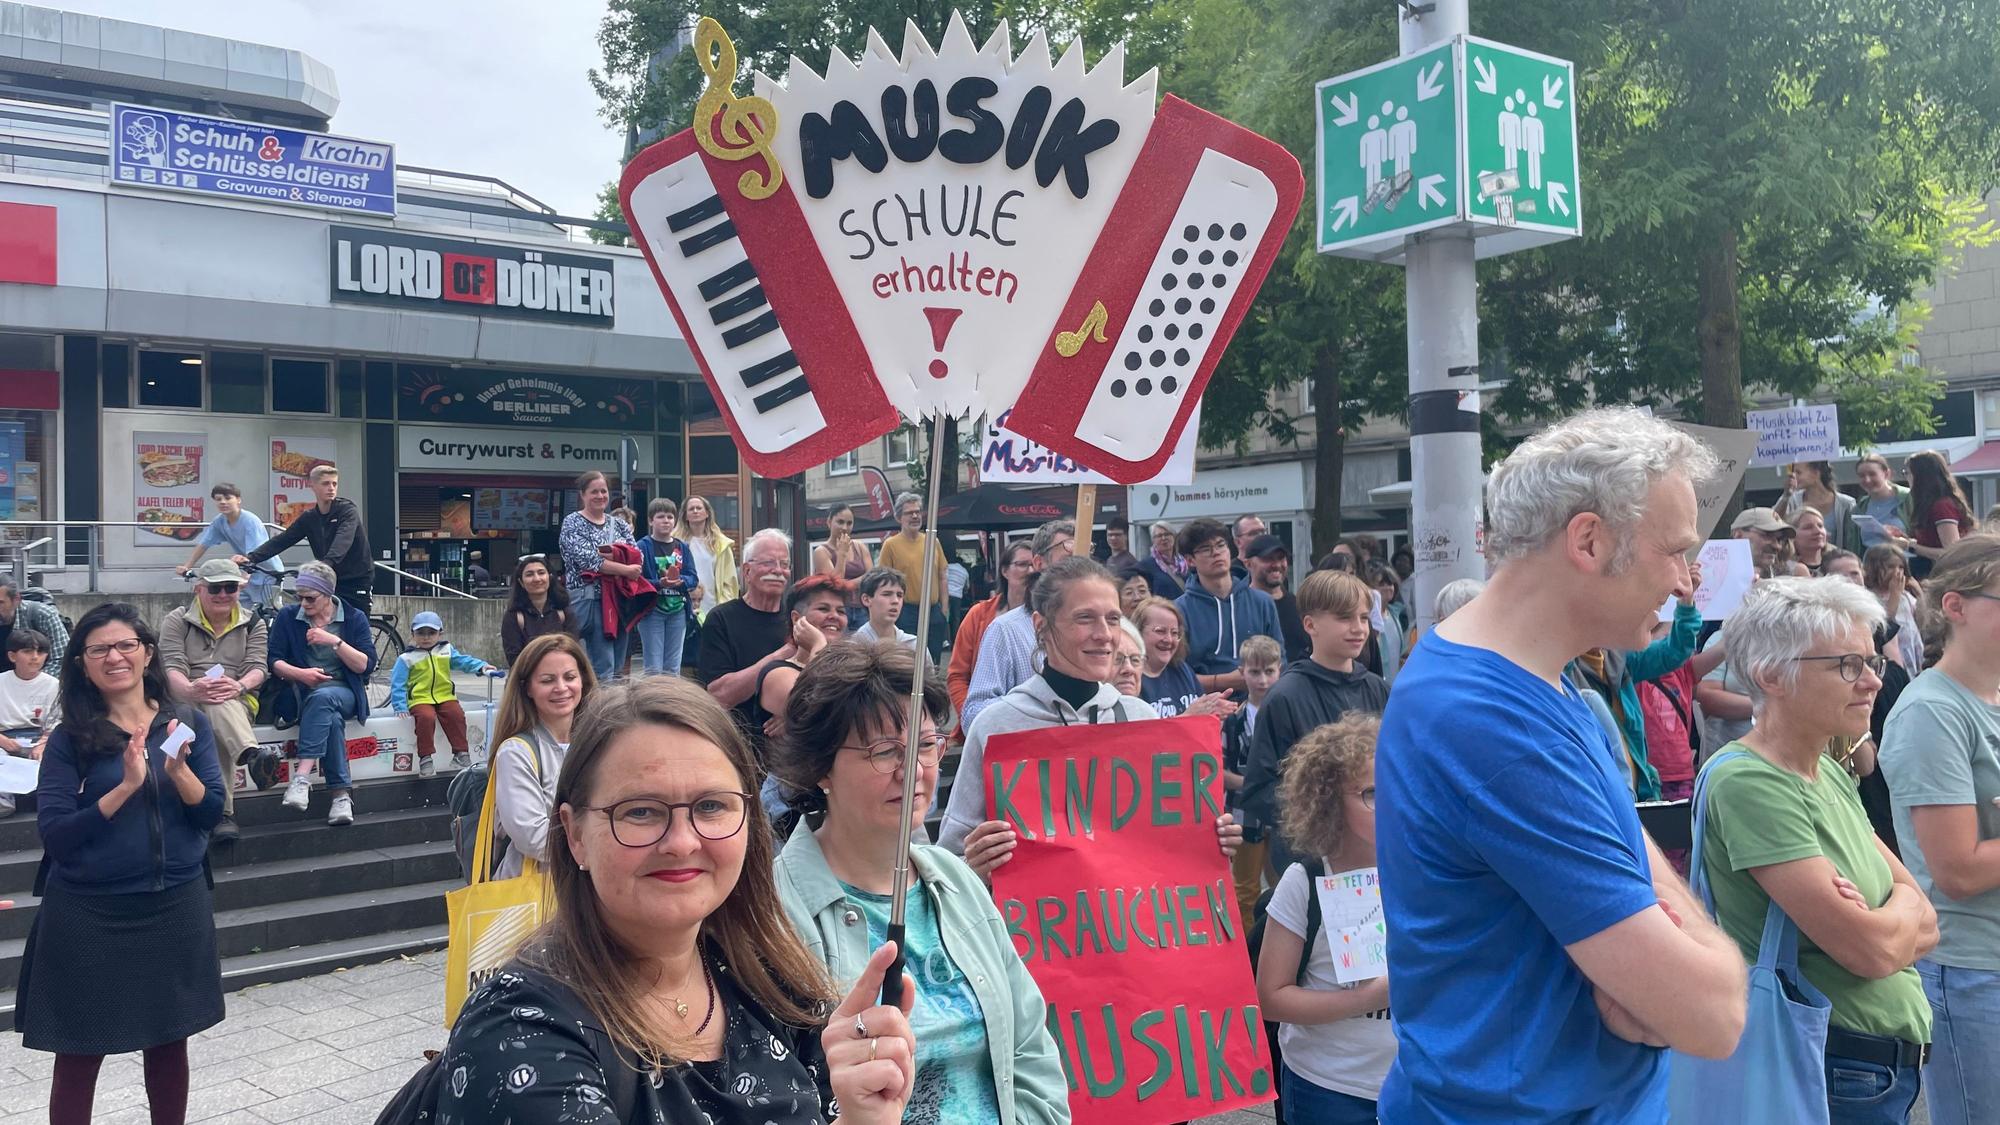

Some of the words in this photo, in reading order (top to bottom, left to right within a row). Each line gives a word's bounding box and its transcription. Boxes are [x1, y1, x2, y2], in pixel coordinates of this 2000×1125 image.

[173, 123, 255, 153] Schuh
[258, 136, 286, 162] &
[309, 139, 385, 168] Krahn
[800, 77, 1120, 199] MUSIK
[173, 147, 370, 191] Schlüsseldienst
[216, 178, 288, 199] Gravuren
[289, 187, 304, 202] &
[306, 189, 367, 208] Stempel
[839, 184, 1024, 260] SCHULE
[337, 239, 442, 300] LORD
[453, 261, 486, 296] OF
[496, 251, 614, 317] DÖNER
[872, 251, 1018, 304] erhalten
[923, 307, 963, 379] !
[476, 382, 507, 404] Unser
[506, 377, 564, 395] Geheimnis
[492, 400, 571, 415] BERLINER
[512, 412, 553, 423] Saucen
[418, 438, 535, 461] Currywurst
[540, 443, 555, 460] &
[560, 444, 618, 462] Pomm
[1213, 486, 1269, 501] hörsysteme
[991, 752, 1222, 840] KINDER
[1006, 878, 1236, 965] BRAUCHEN
